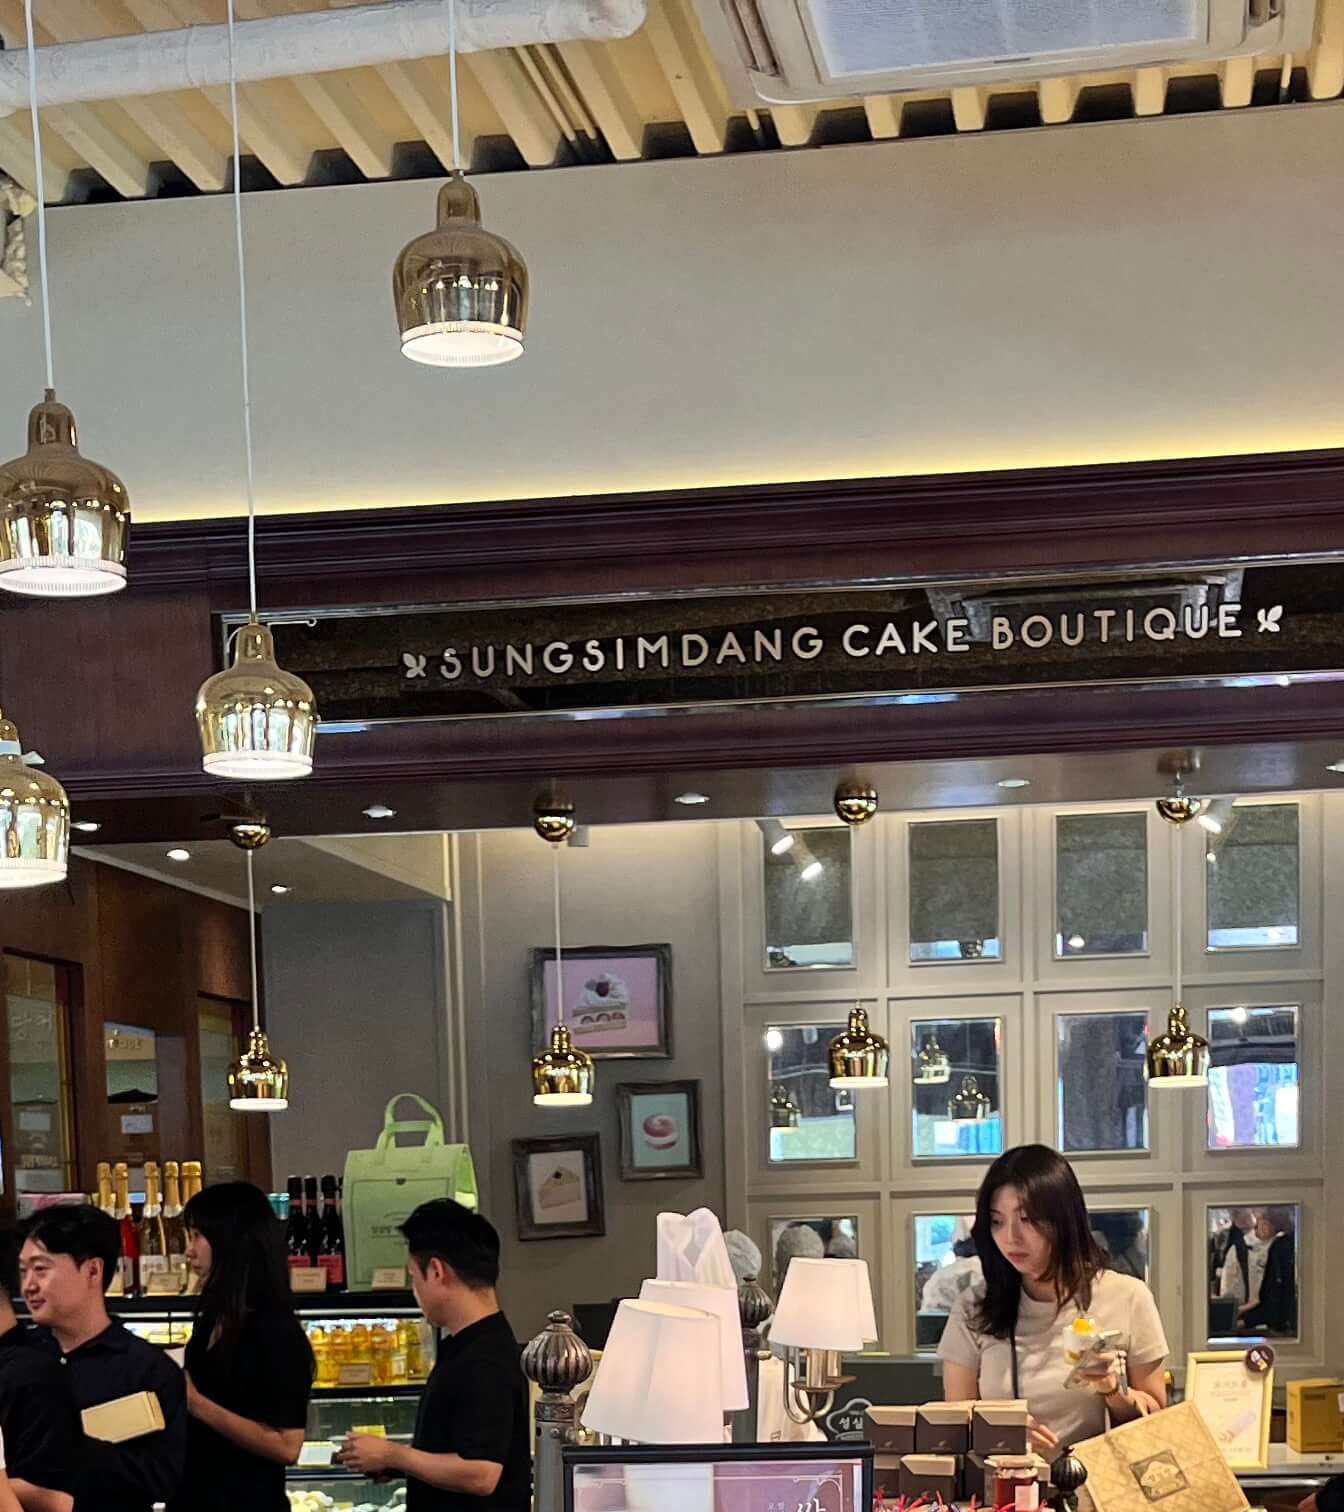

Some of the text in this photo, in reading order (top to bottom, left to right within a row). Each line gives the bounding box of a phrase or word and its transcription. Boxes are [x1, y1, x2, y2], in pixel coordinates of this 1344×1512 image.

[439, 604, 1242, 681] SUNGSIMDANG CAKE BOUTIQUE
[839, 1416, 863, 1429] 성심
